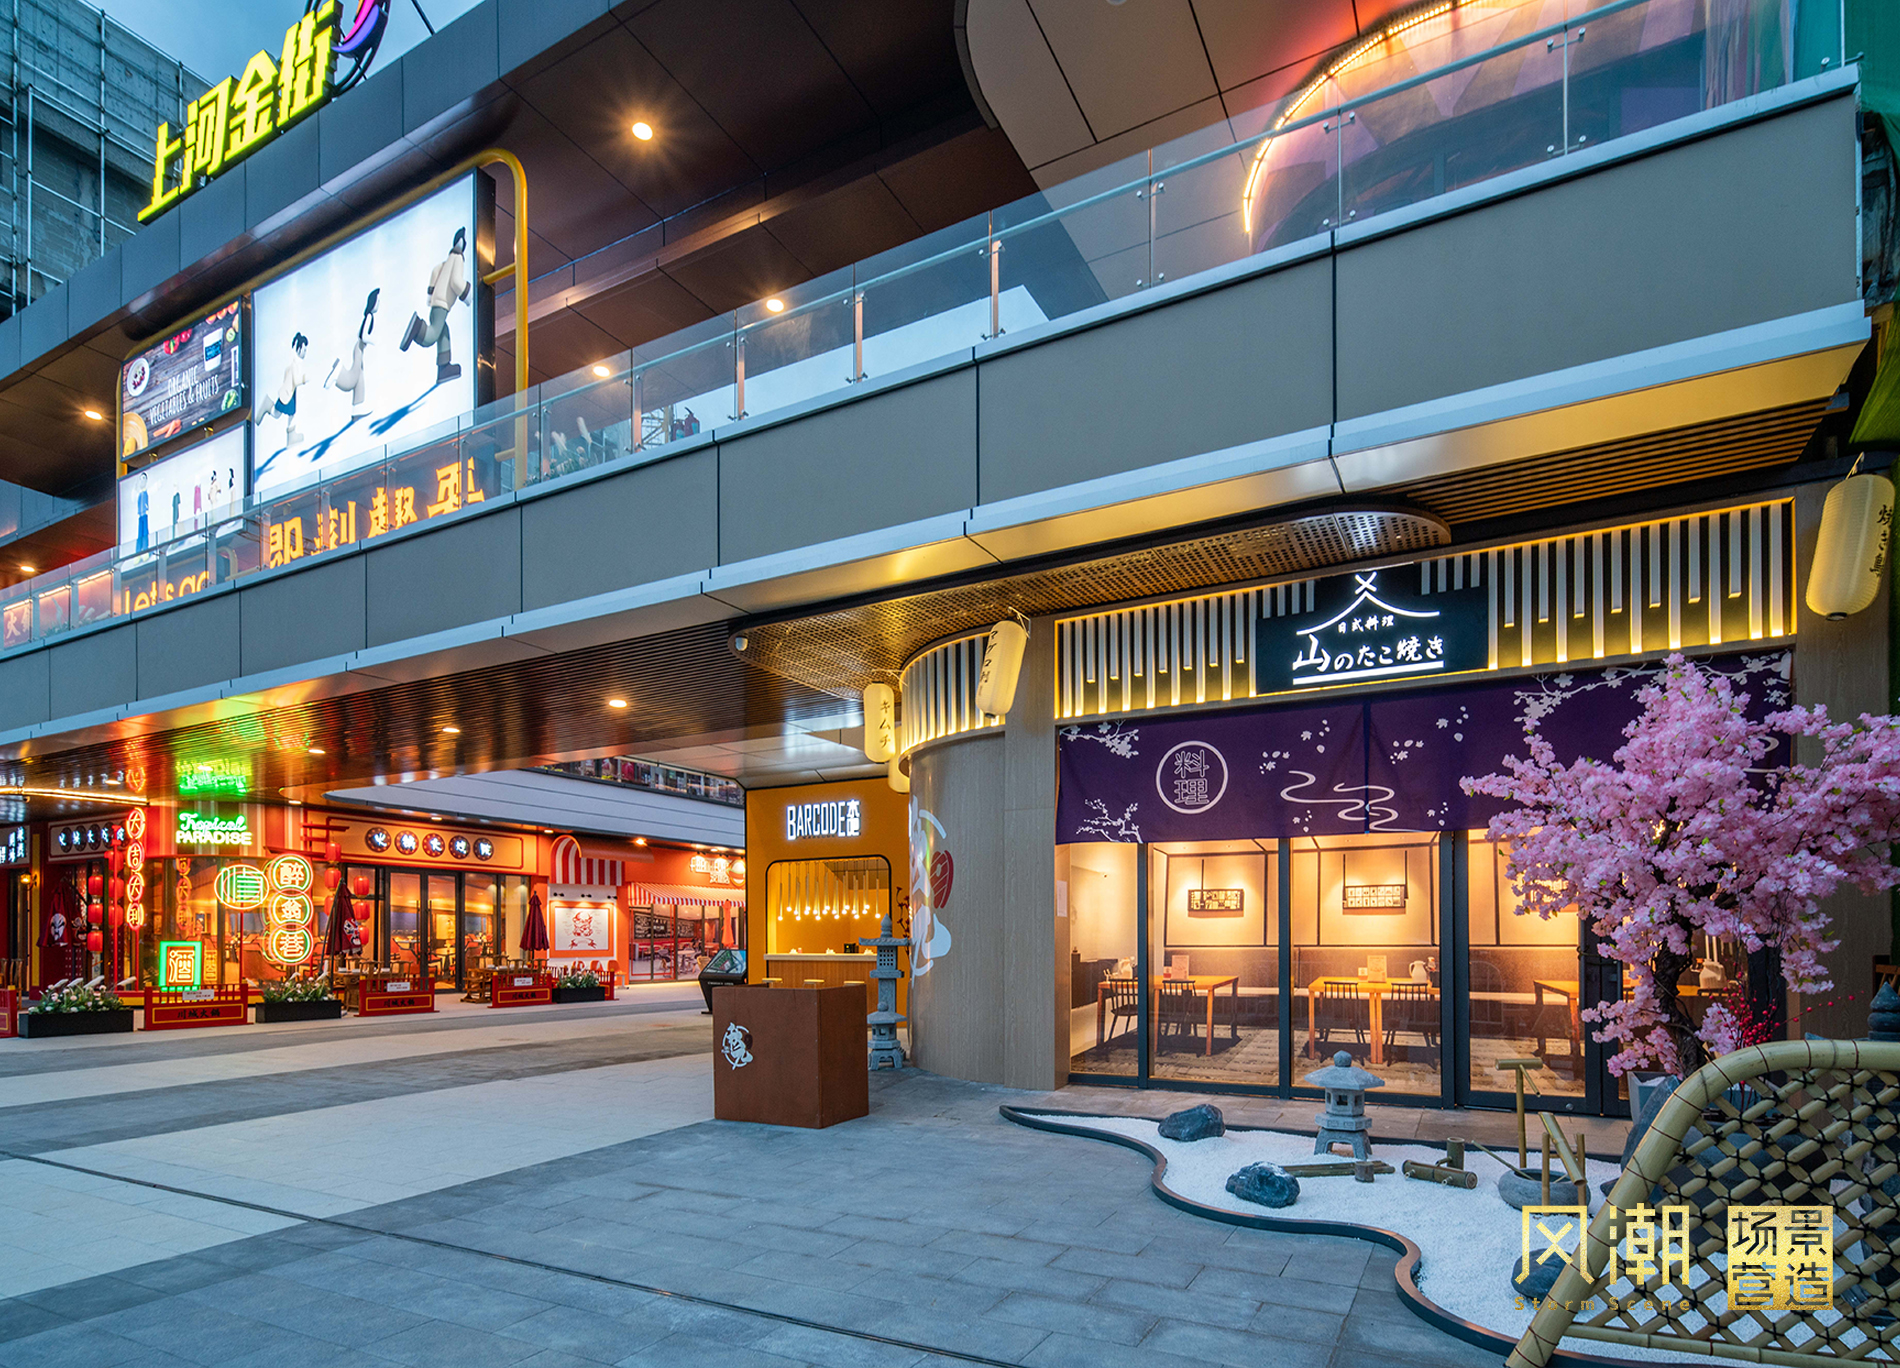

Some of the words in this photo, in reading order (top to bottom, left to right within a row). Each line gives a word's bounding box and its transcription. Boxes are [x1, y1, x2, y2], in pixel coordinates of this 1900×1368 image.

[137, 0, 338, 223] 上河金街
[149, 391, 187, 425] VEGETABLES
[188, 384, 195, 404] &
[195, 374, 219, 402] FRUITS
[167, 365, 199, 396] ORGANIC
[1337, 614, 1394, 634] 日式料理
[1292, 633, 1444, 672] 山のたこ焼き
[879, 699, 891, 749] キムチ
[1173, 749, 1210, 806] 料理
[176, 830, 253, 845] PARADISE
[179, 812, 248, 833] Tropical
[787, 801, 846, 840] BARCODE
[129, 812, 143, 925] 大吉大利
[278, 860, 306, 959] 醉翁巷
[168, 949, 196, 983] 酒
